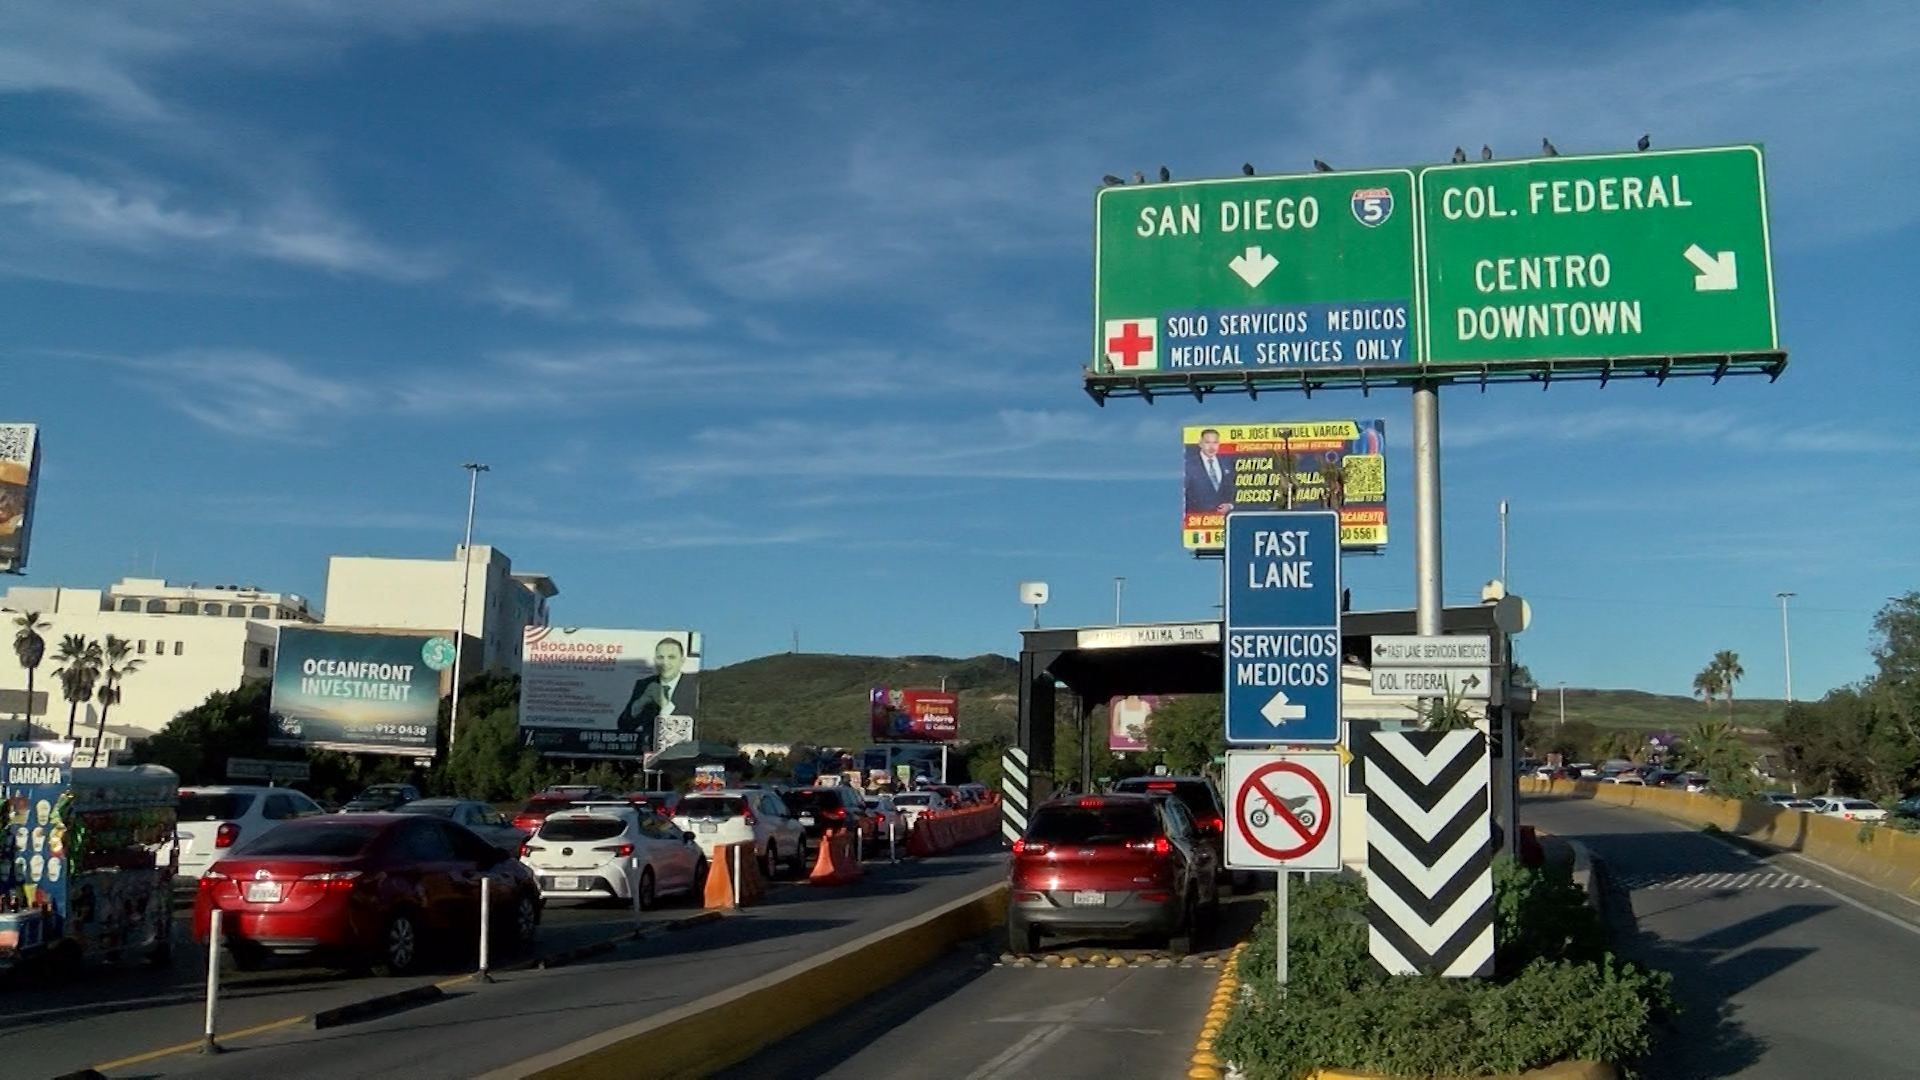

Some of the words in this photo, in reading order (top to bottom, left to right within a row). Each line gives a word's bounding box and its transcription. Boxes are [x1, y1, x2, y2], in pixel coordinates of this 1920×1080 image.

[1442, 185, 1518, 221] COL.
[1529, 175, 1693, 214] FEDERAL
[1137, 203, 1200, 237] SAN
[1221, 196, 1319, 232] DIEGO
[1364, 199, 1383, 222] 5
[1475, 253, 1611, 293] CENTRO
[1168, 315, 1209, 338] SOLO
[1219, 311, 1308, 336] SERVICIOS
[1327, 308, 1406, 331] MEDICOS
[1457, 300, 1643, 341] DOWNTOWN
[1171, 344, 1244, 367] MEDICAL
[1256, 340, 1343, 365] SERVICES
[1356, 339, 1403, 361] ONLY
[1230, 428, 1245, 441] DR.
[1312, 424, 1350, 438] VARGAS
[1235, 473, 1267, 487] DOLOR
[1235, 489, 1271, 502] DISCOS
[1255, 531, 1310, 557] FAST
[1249, 561, 1314, 588] LANE
[531, 641, 603, 655] ABOGADOS
[606, 645, 624, 655] DE
[1230, 633, 1337, 658] SERVICIOS
[1423, 644, 1457, 658] SERVICIOS
[303, 659, 414, 682] OCEANFRONT
[1237, 663, 1330, 686] MEDICOS
[301, 678, 411, 702] INVESTMENT
[8, 747, 47, 764] NIEVES
[9, 767, 61, 784] GARRAFA
